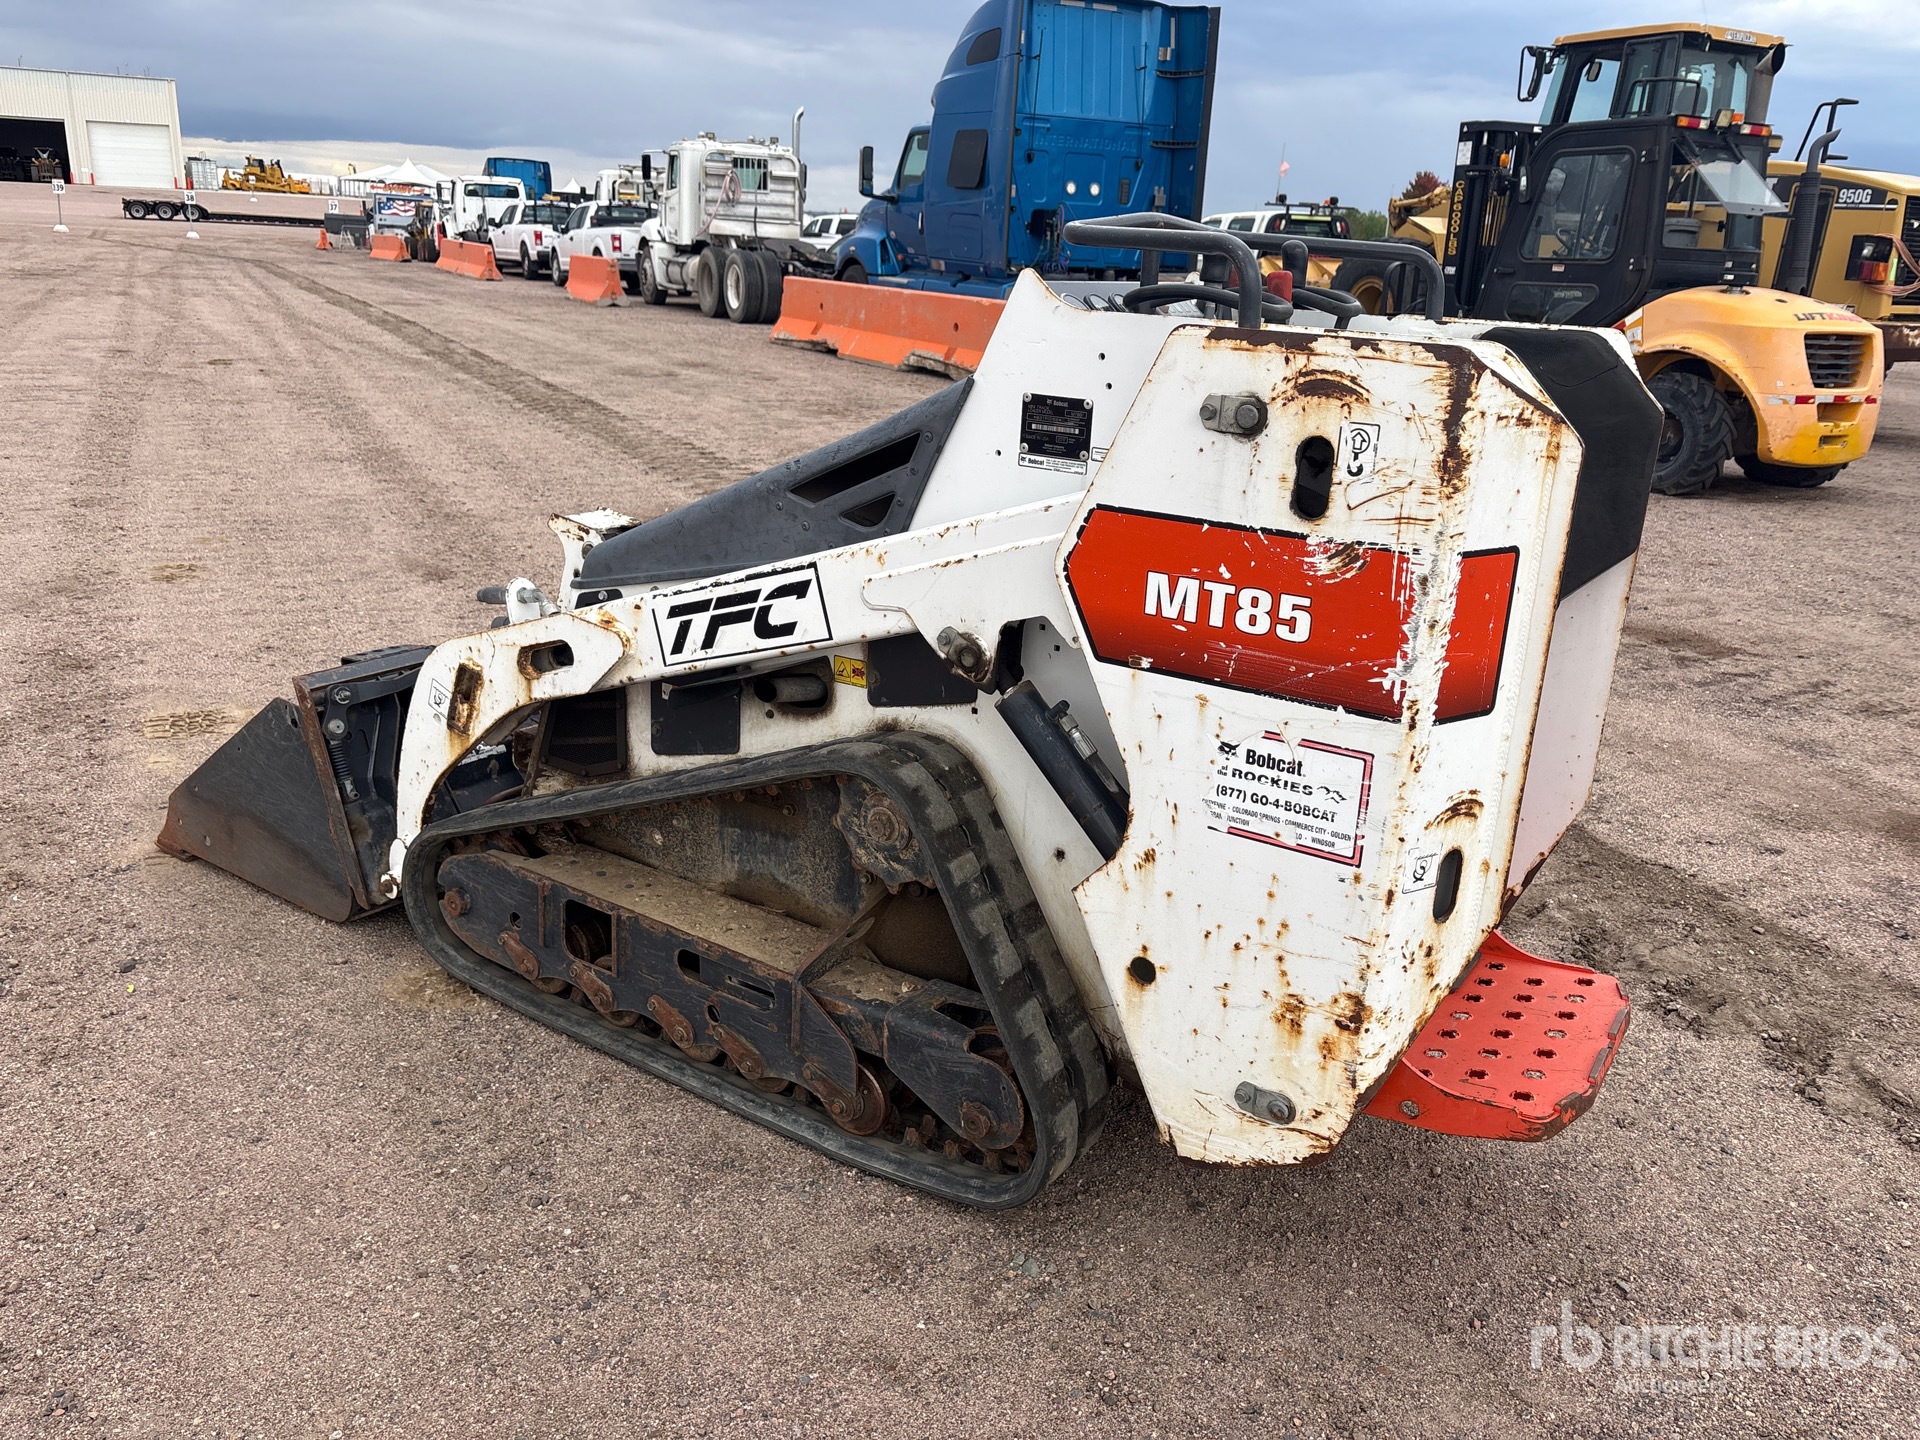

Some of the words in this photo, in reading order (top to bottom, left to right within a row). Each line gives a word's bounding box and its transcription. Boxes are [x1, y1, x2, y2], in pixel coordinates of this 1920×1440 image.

[1034, 133, 1137, 153] INTERNATIONAL
[1454, 180, 1465, 203] CAP
[1838, 188, 1873, 204] 950G
[1450, 203, 1462, 233] 6000
[1027, 457, 1045, 467] Bobcat
[666, 578, 814, 655] TFC
[1143, 570, 1313, 643] MT85
[1217, 768, 1228, 777] the
[1245, 748, 1304, 776] Bobcat
[1231, 767, 1314, 796] ROCKIES
[1216, 783, 1247, 803] (877)
[1250, 792, 1338, 823] GO-4-BOBCAT
[1232, 805, 1259, 818] COLORADO
[1259, 812, 1281, 824] SPRINGS
[1315, 826, 1327, 836] CITY
[1330, 830, 1352, 842] GOLDEN
[1311, 836, 1336, 849] WINDSOR
